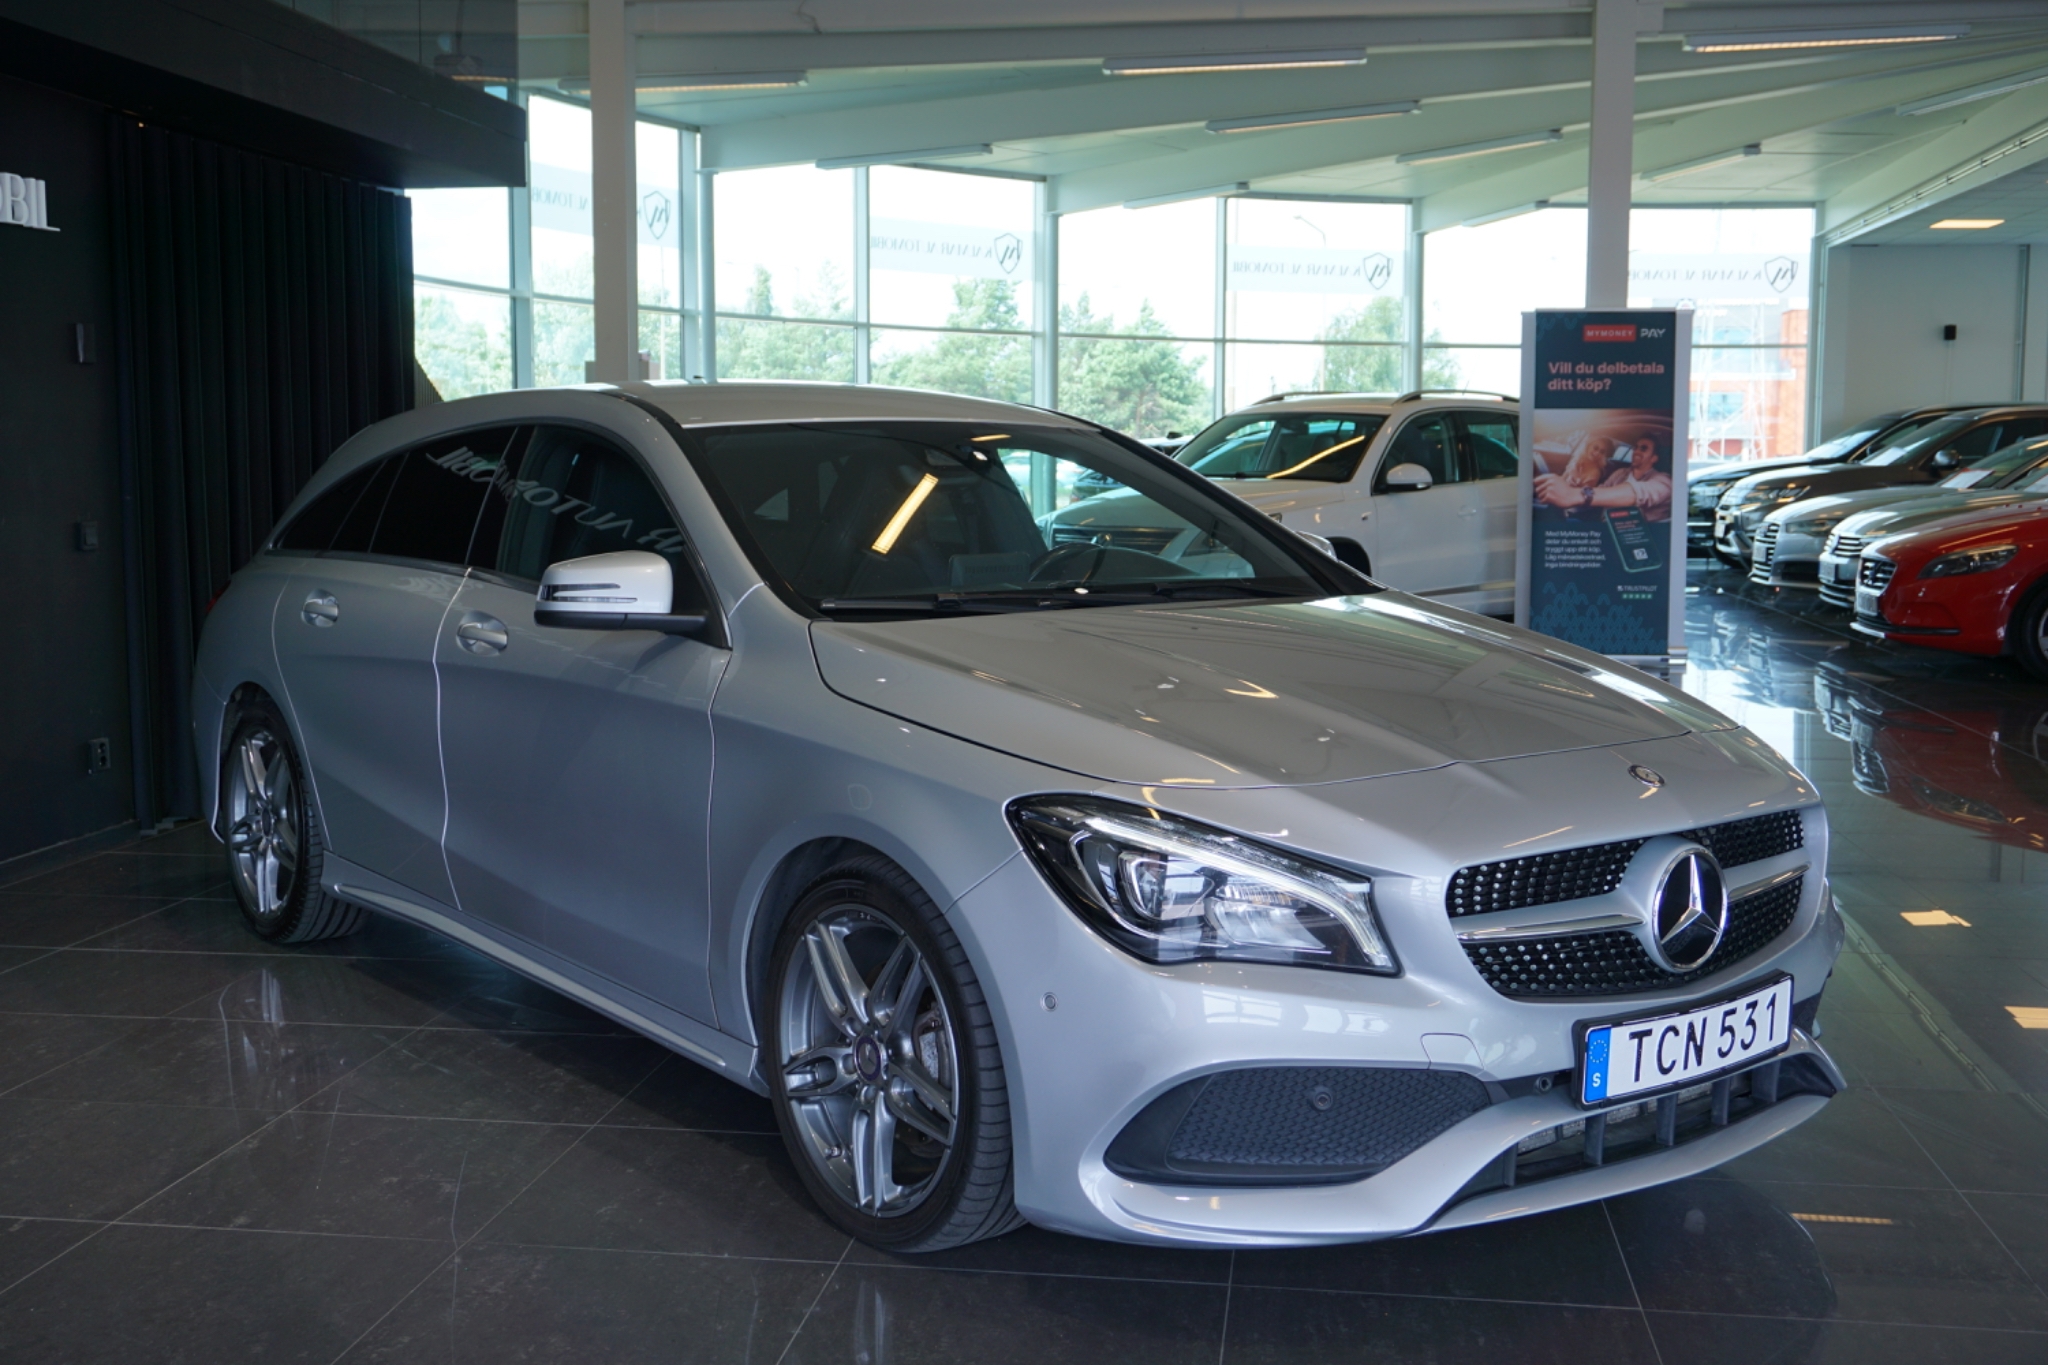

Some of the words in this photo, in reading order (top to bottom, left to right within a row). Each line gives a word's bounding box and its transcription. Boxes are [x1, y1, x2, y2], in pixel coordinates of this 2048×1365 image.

[1586, 329, 1634, 337] MYMONEY
[1640, 328, 1666, 338] PAY
[1548, 362, 1572, 374] Vill
[1575, 362, 1594, 374] du
[1597, 362, 1665, 374] delbetala
[1547, 378, 1574, 391] ditt
[1577, 378, 1612, 393] köp?
[1628, 1017, 1707, 1083] TCN
[1717, 992, 1777, 1059] 531
[1592, 1073, 1601, 1088] S
